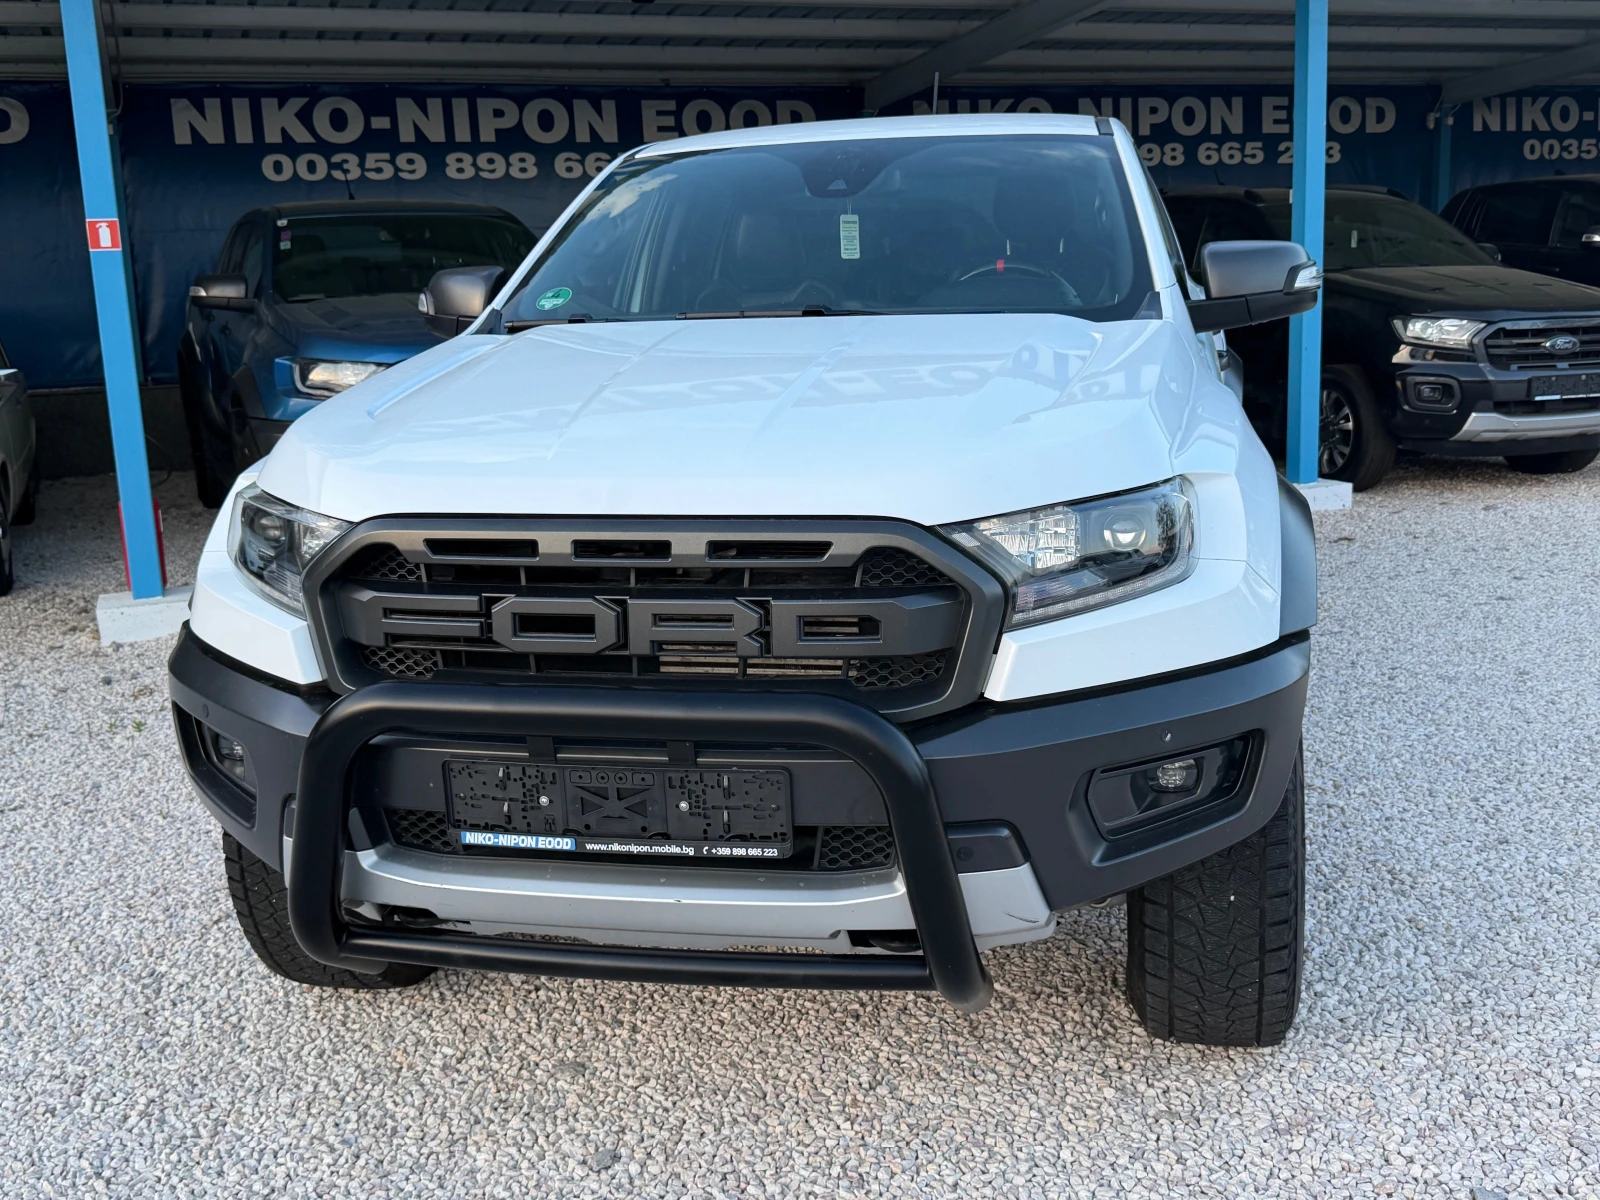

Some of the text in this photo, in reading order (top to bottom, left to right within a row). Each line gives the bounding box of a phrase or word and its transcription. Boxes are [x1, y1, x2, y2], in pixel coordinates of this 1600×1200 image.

[170, 96, 817, 145] NIKO-NIPON EOOD
[1262, 96, 1396, 134] EOD
[1473, 96, 1600, 132] NIKO-
[1139, 141, 1341, 167] 98 665 23
[1523, 138, 1600, 160] 0035
[261, 151, 618, 182] 00359 898 66
[1555, 338, 1574, 350] Ford
[348, 592, 905, 657] FORD
[465, 831, 572, 850] NIKO-NIPON EOOD
[585, 842, 778, 857] www.nikonipon.mobile.bg +359 898 665 223
